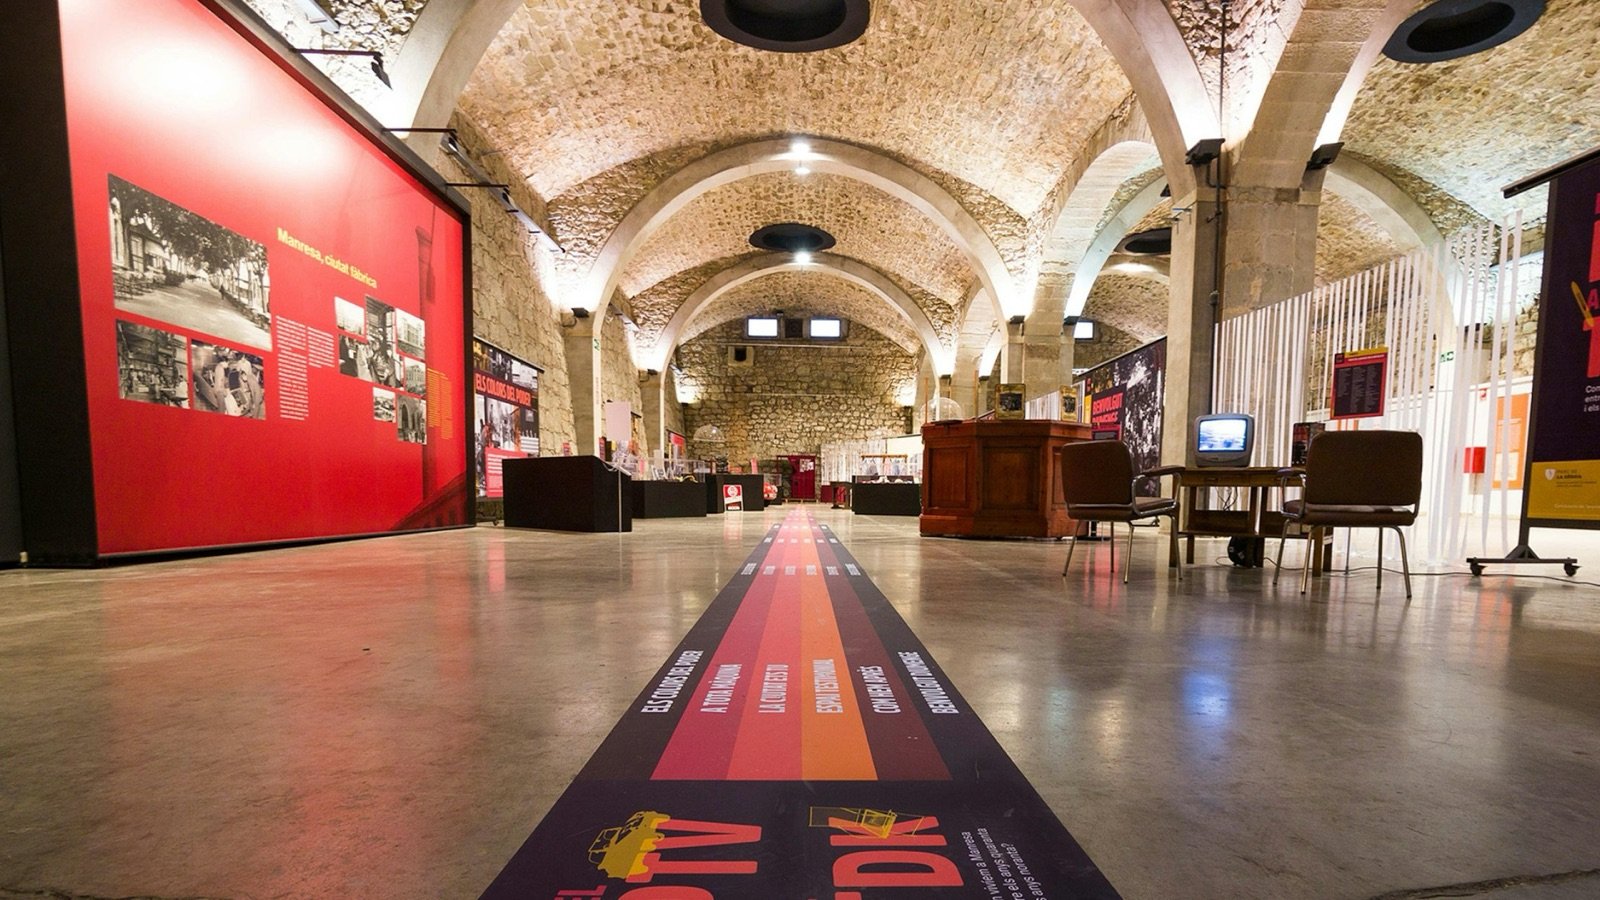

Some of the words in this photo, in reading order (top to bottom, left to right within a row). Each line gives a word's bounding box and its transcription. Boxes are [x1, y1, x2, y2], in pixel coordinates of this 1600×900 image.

[277, 227, 324, 264] Manresa,
[324, 254, 349, 275] ciutat
[474, 372, 487, 392] ELS
[667, 665, 695, 676] DEL
[651, 676, 689, 699] COLORS
[865, 683, 894, 698] HEM
[911, 676, 960, 714] BENVOLGUT
[641, 700, 674, 713] ELS
[702, 690, 735, 706] TOTA
[758, 703, 786, 713] LA
[815, 693, 844, 714] ESPAI
[870, 698, 902, 714] COM
[961, 831, 984, 861] Manresa
[977, 827, 1003, 859] quaranta
[994, 859, 1012, 878] anys
[1000, 842, 1032, 876] noranta?
[1003, 878, 1019, 891] els
[1023, 876, 1044, 896] anys
